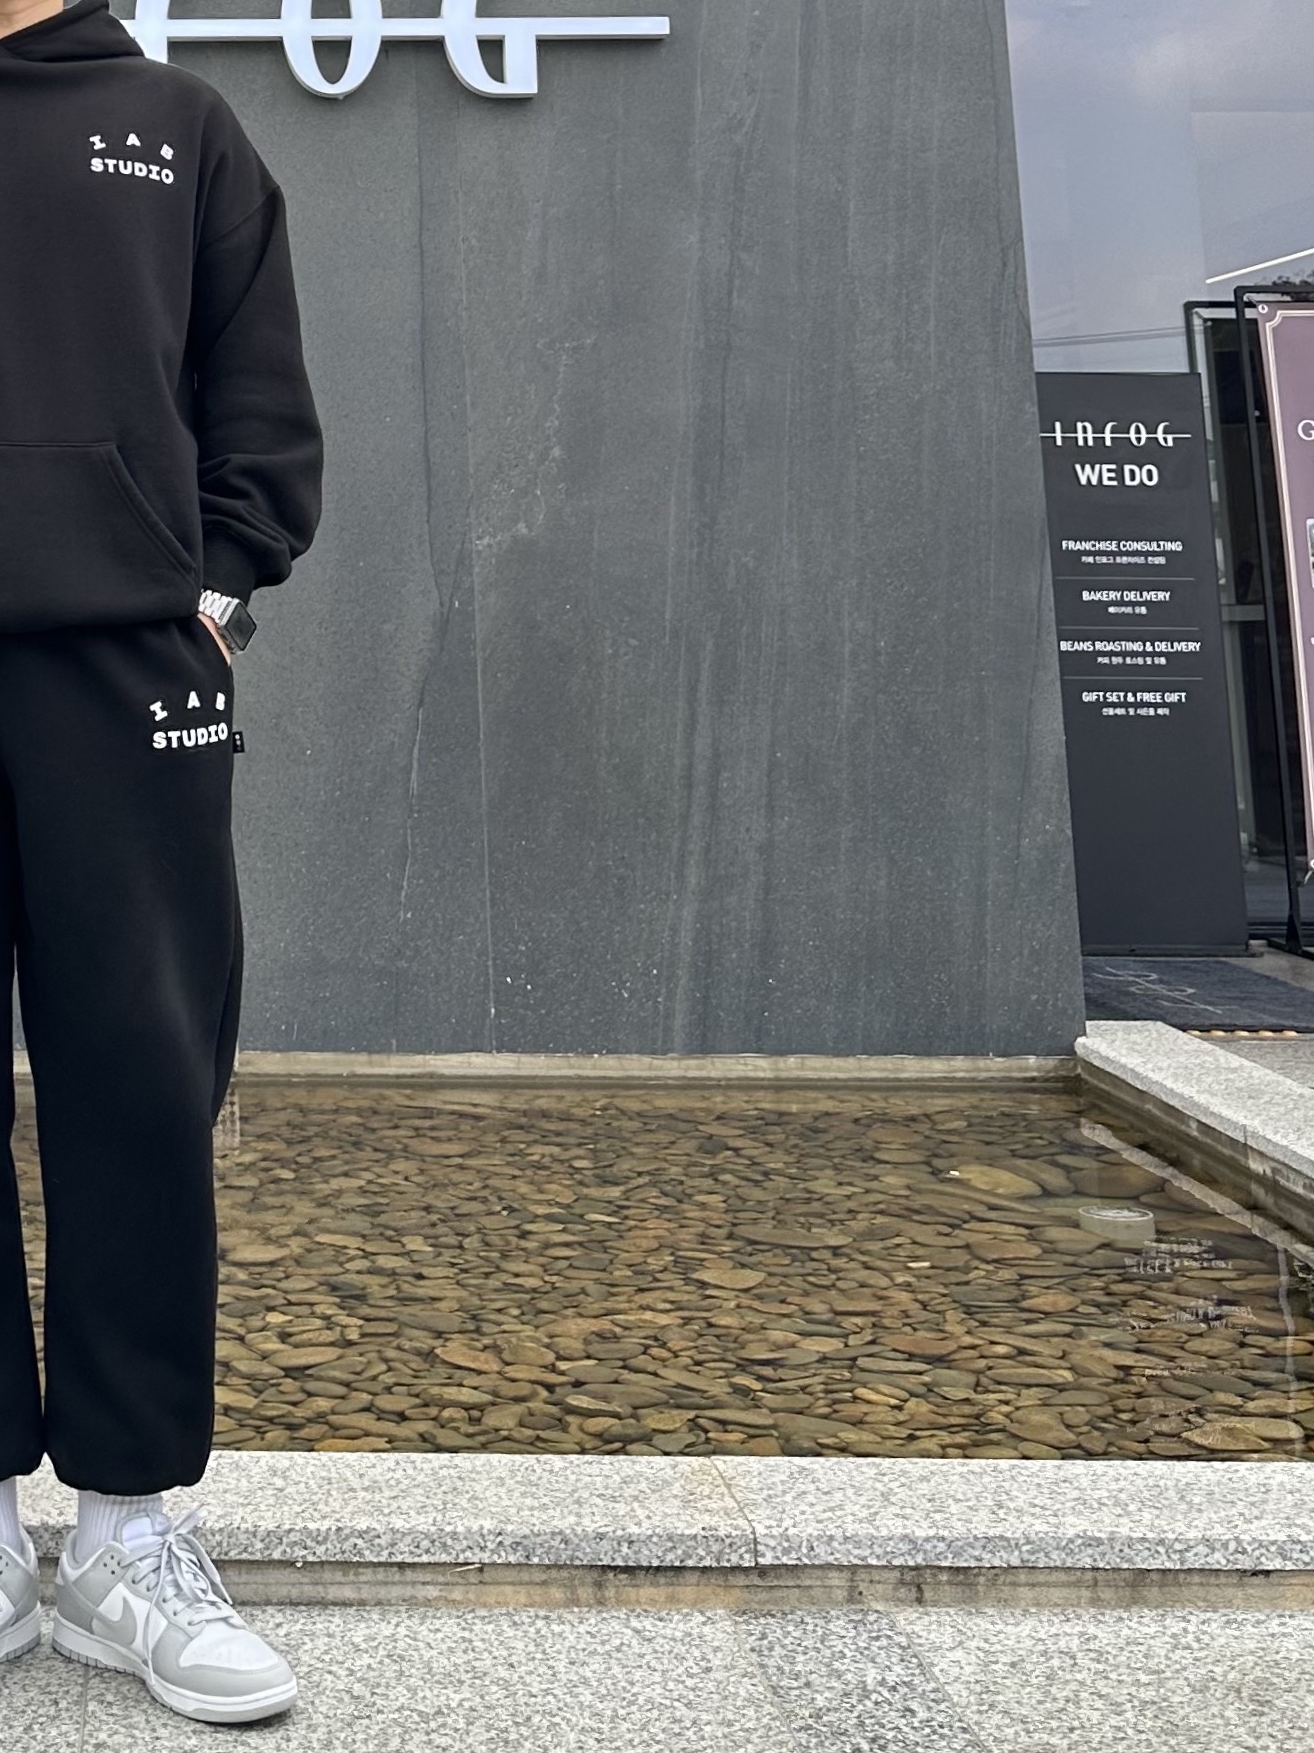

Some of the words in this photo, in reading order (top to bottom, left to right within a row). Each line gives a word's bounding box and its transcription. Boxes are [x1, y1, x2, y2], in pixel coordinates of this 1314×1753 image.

[90, 157, 174, 185] STUDIO
[1074, 463, 1118, 486] WE
[1123, 464, 1159, 486] DO
[1061, 540, 1118, 551] FRANCHISE
[1119, 540, 1183, 552] CONSULTING
[1082, 590, 1122, 601] BAKERY
[1123, 590, 1171, 602] DELIVERY
[1060, 640, 1093, 651] BEANS
[1094, 641, 1144, 652] ROASTING
[1145, 641, 1153, 652] &
[1154, 641, 1201, 652] DELIVERY
[1082, 691, 1104, 702] GIFT
[1106, 692, 1125, 702] SET
[1126, 692, 1135, 702] &
[1136, 692, 1163, 702] FREE
[1164, 692, 1187, 703] GIFT
[152, 722, 228, 749] STUDIO
